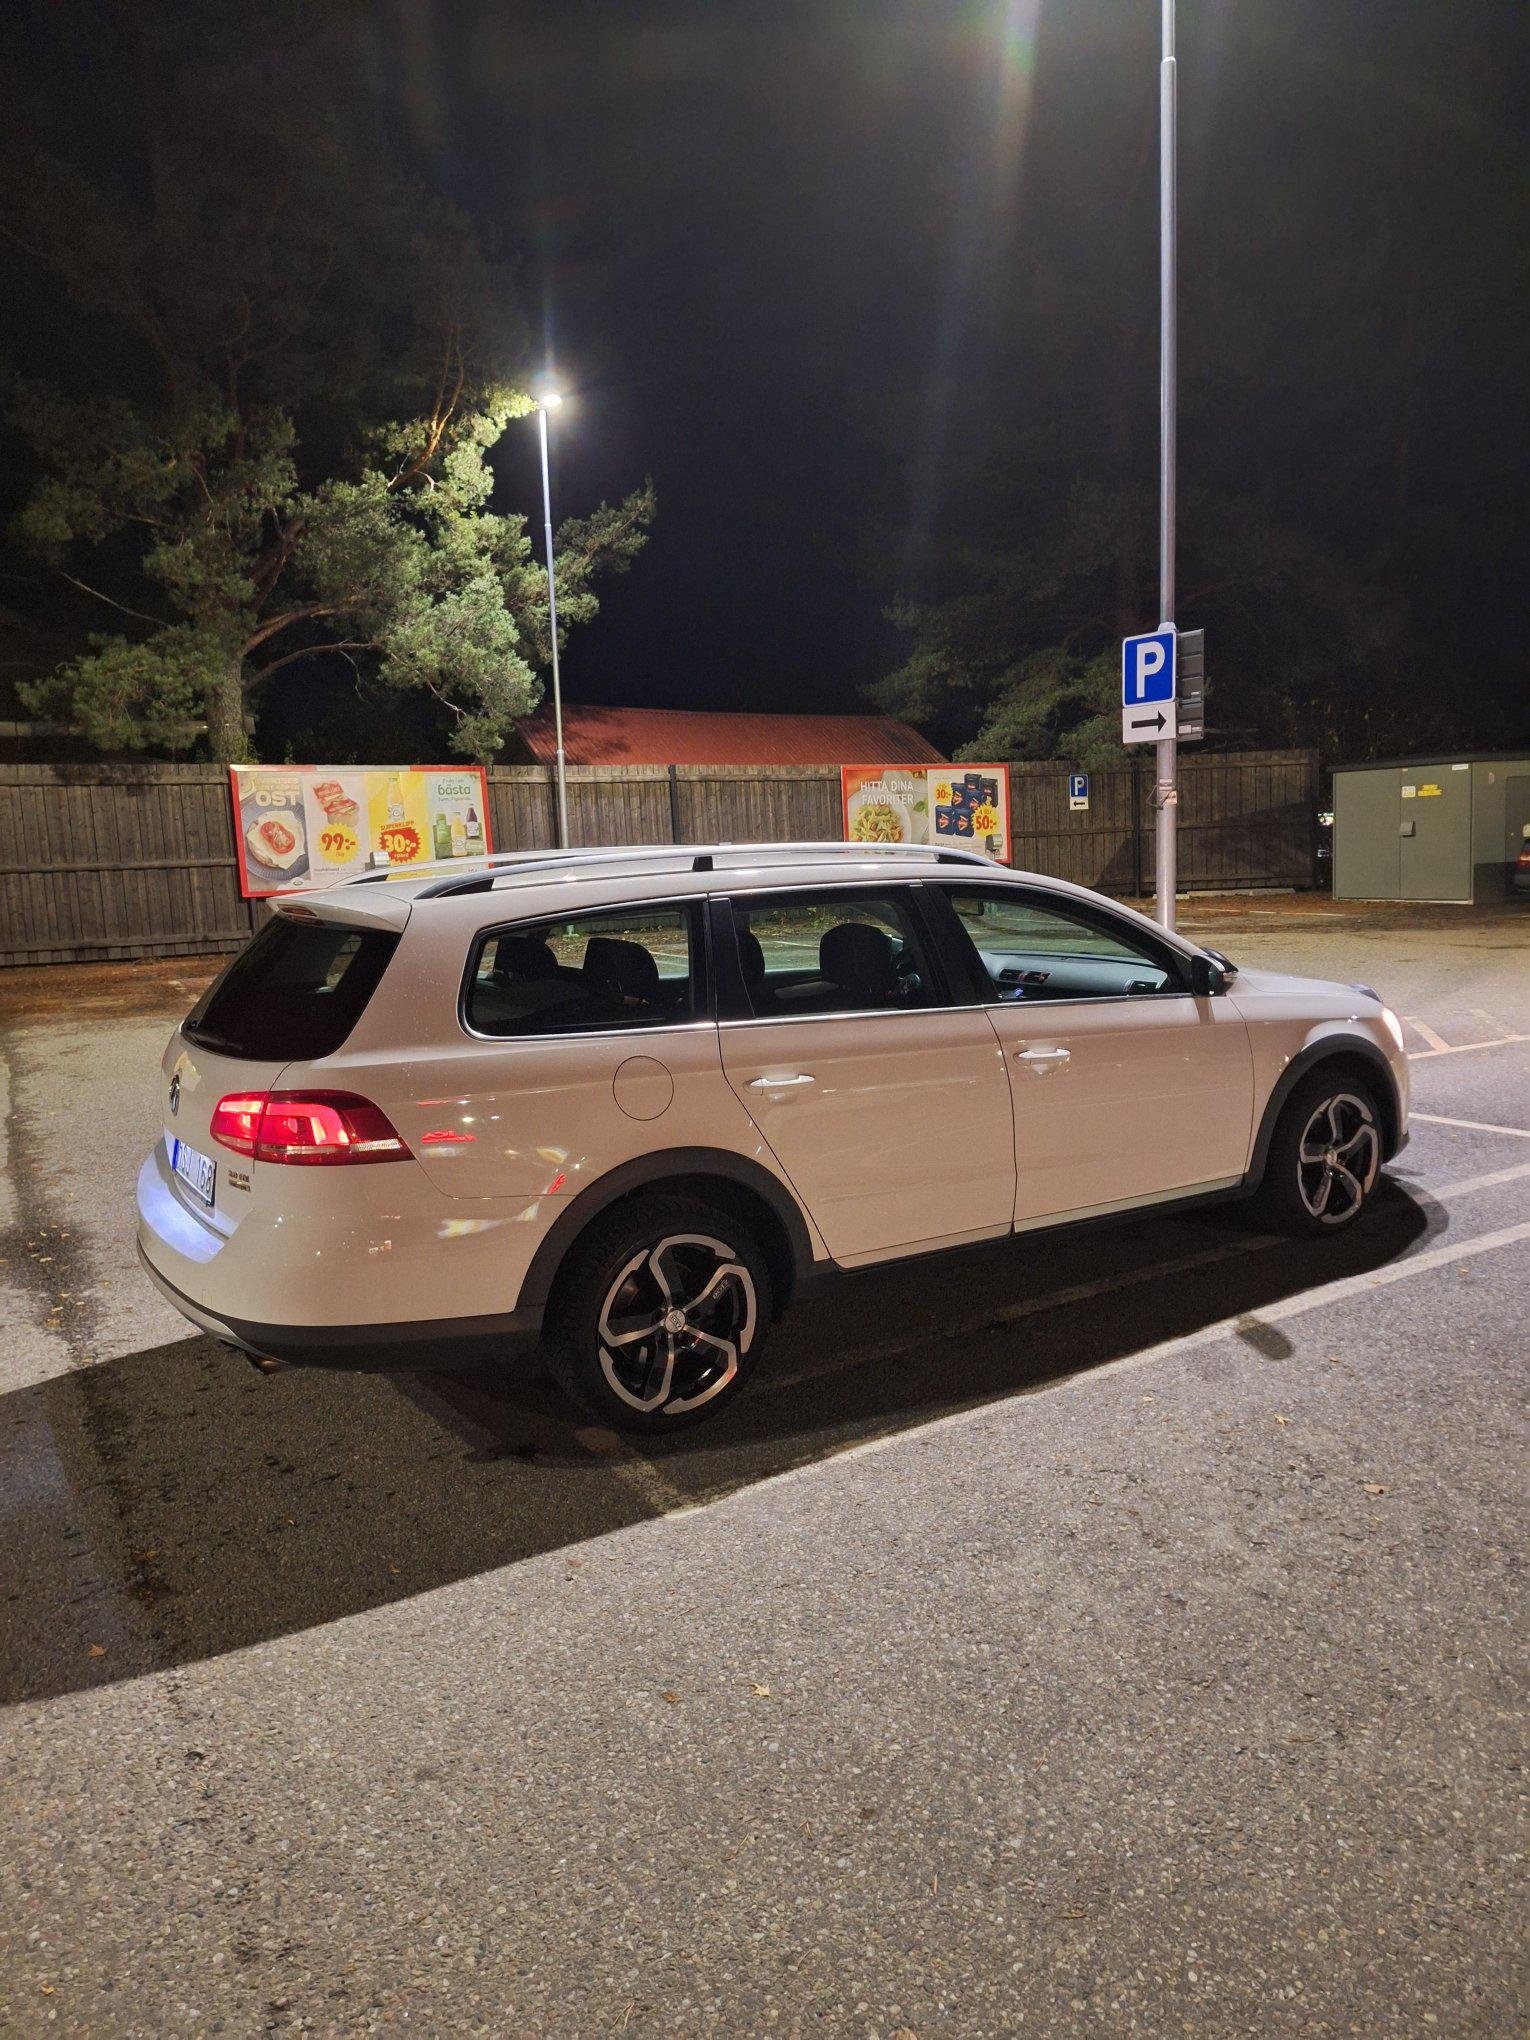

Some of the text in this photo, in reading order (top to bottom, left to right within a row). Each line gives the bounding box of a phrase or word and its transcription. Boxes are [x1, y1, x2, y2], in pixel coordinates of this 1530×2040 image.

[1136, 641, 1165, 698] P
[437, 784, 471, 796] bästa
[861, 781, 914, 791] HITTA DINA
[1074, 776, 1085, 796] P
[255, 790, 300, 807] OST
[862, 794, 914, 805] FAVORITER
[976, 815, 997, 830] 50:-
[321, 832, 356, 851] 99:-
[383, 833, 416, 853] 30:-
